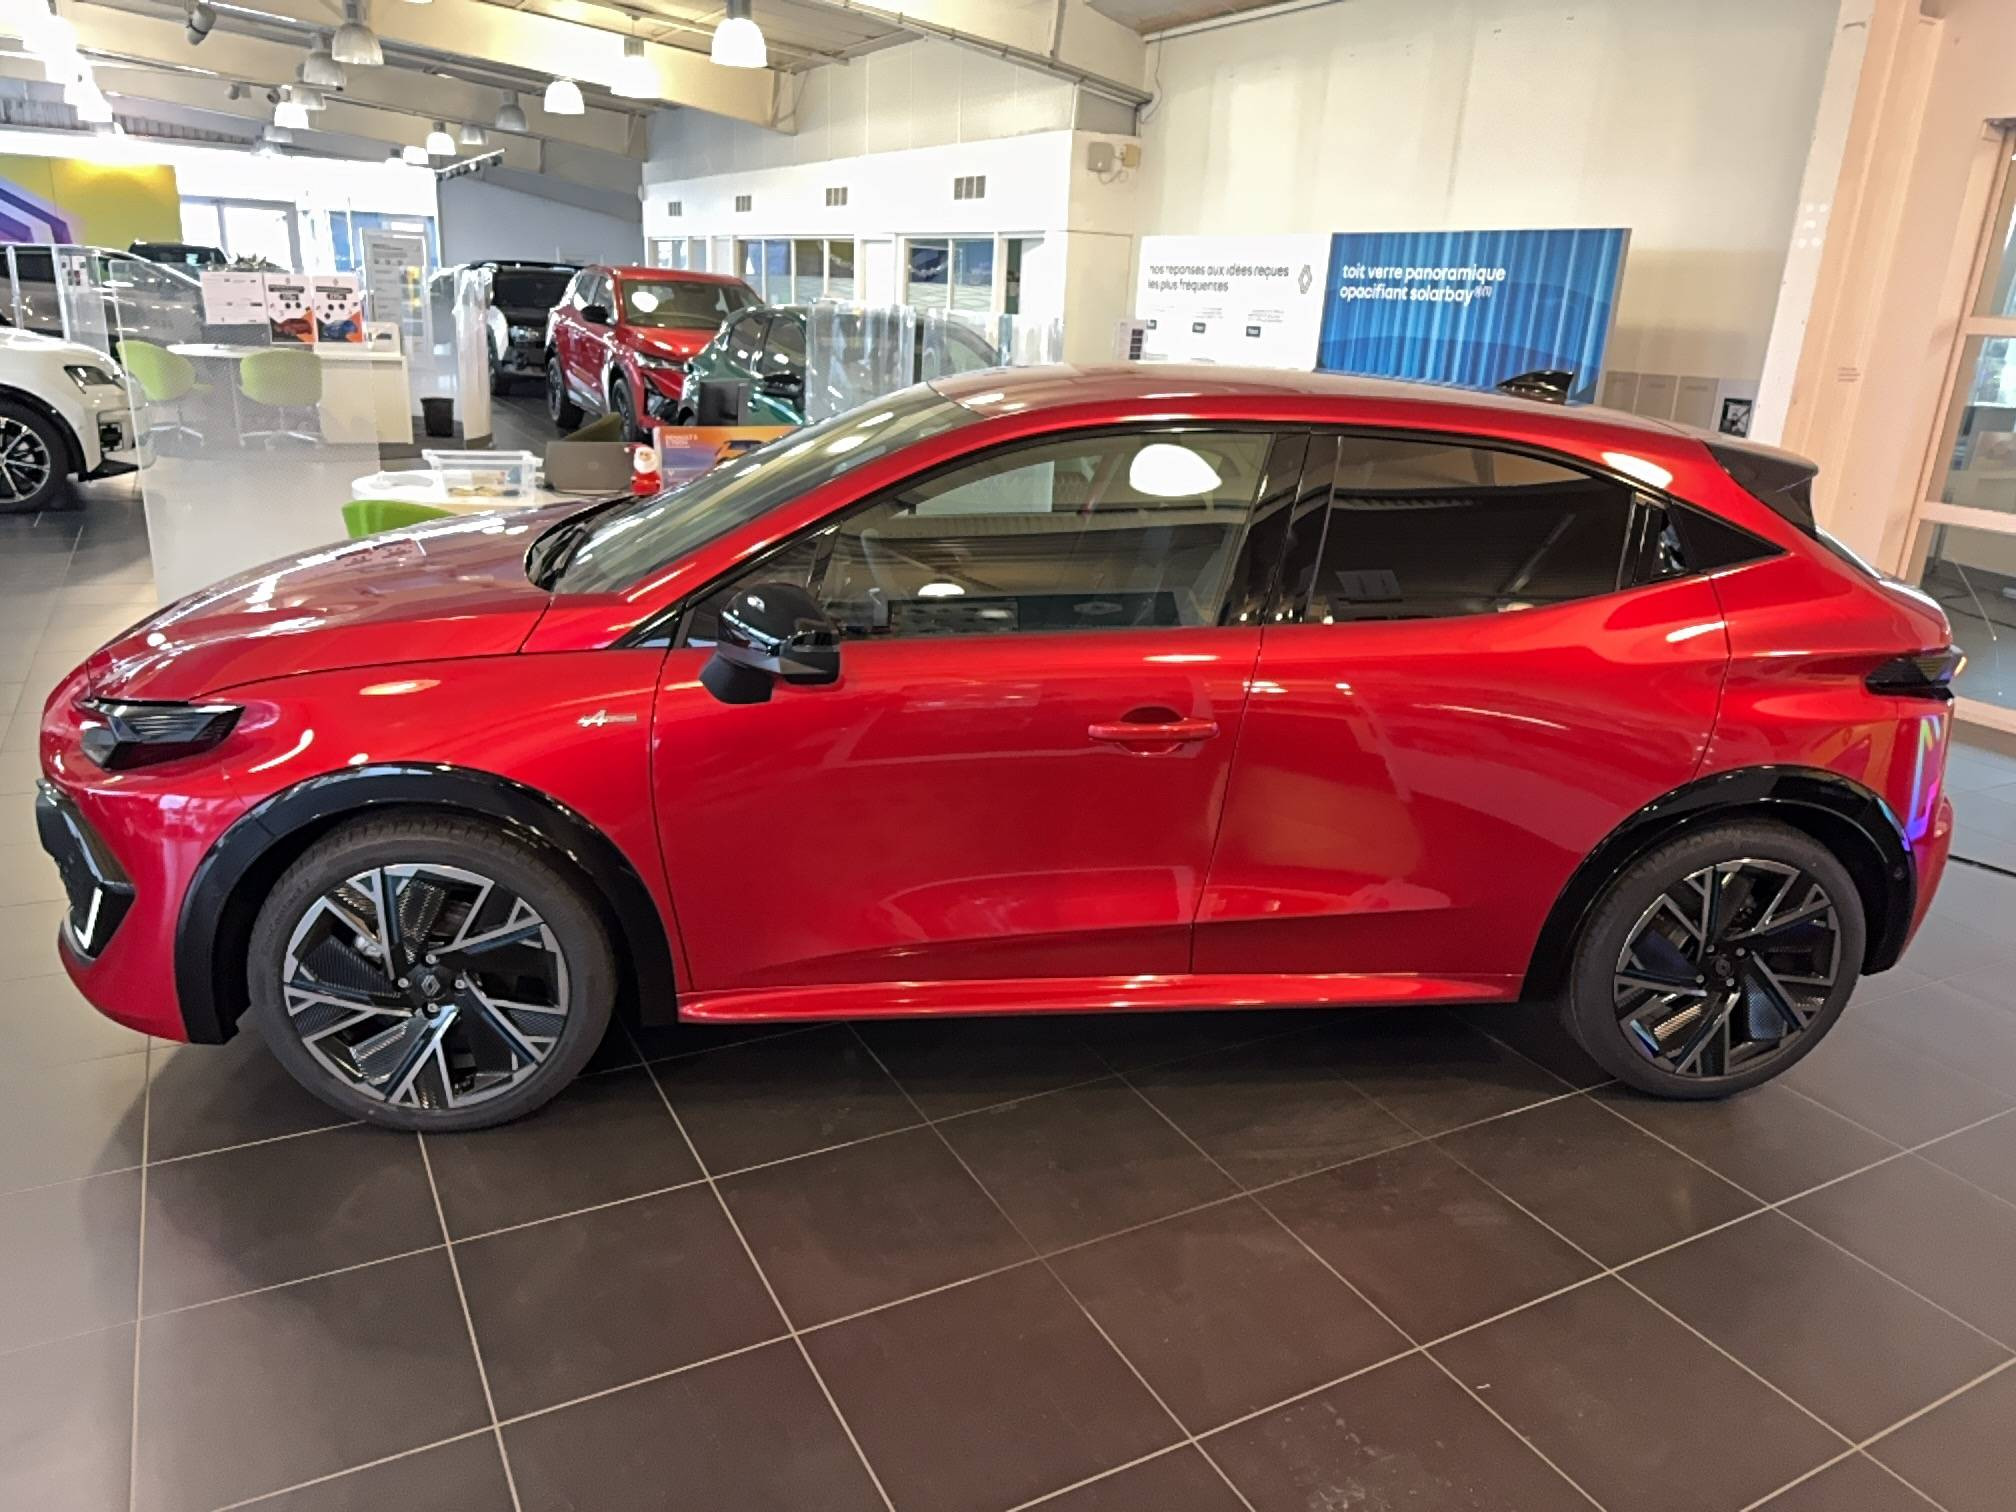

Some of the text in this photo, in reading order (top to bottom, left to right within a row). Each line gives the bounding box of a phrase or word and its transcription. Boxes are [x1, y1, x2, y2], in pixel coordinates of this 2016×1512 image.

[1207, 265, 1225, 276] aux
[1343, 263, 1506, 285] toit verre panoramique
[1160, 280, 1178, 292] plus
[1340, 283, 1408, 303] opacifiant
